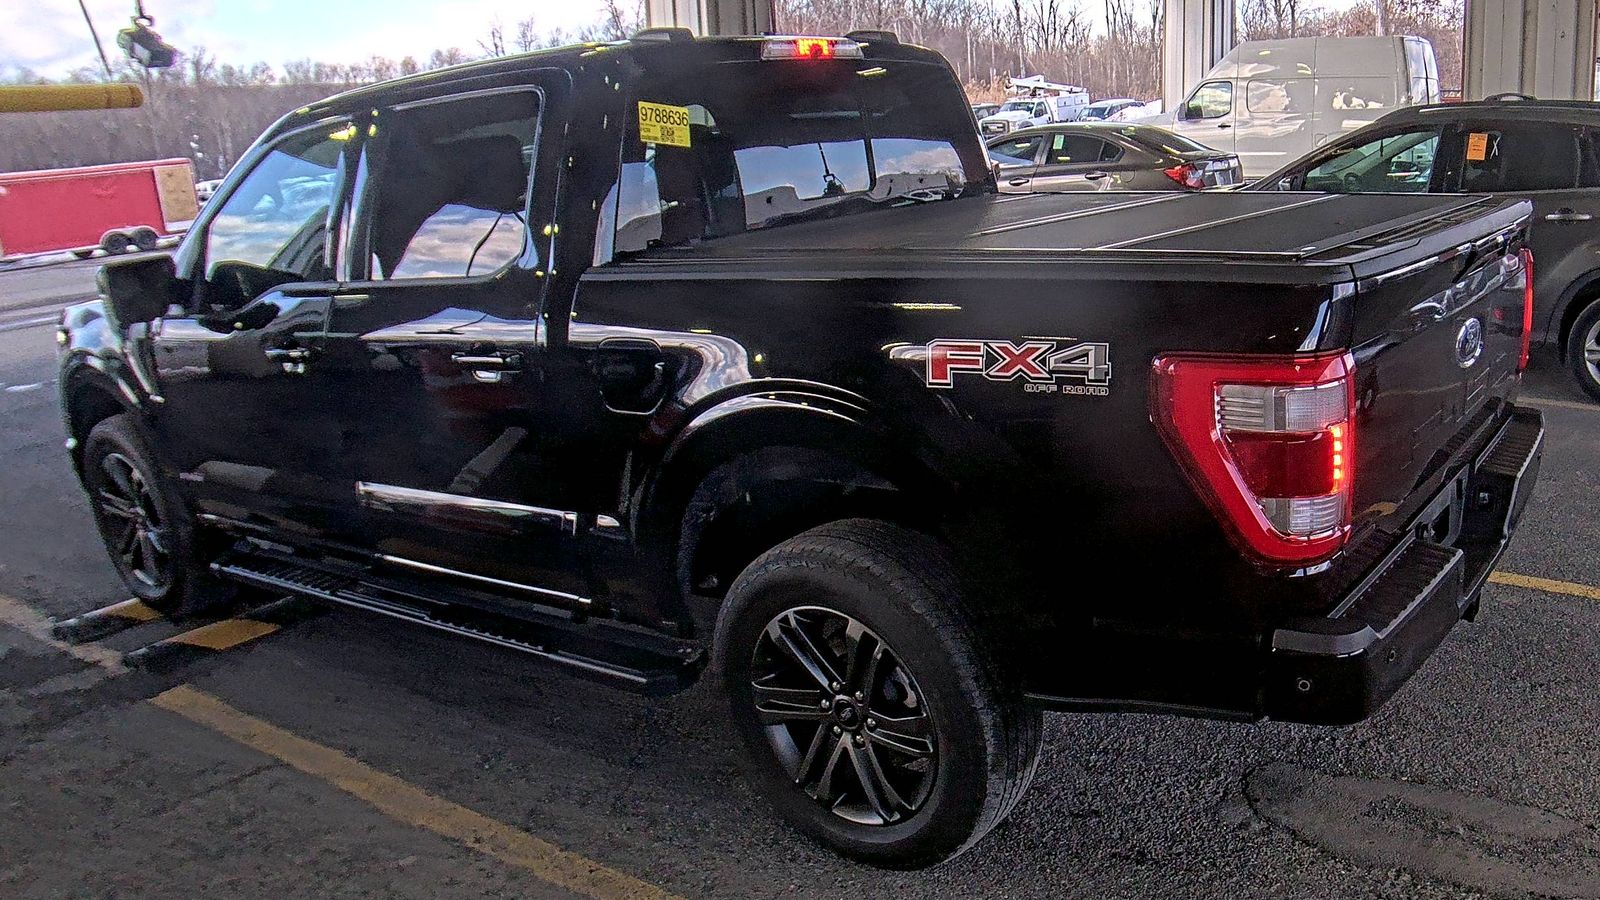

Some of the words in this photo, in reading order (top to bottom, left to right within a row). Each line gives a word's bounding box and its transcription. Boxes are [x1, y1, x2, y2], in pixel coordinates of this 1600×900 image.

[640, 106, 689, 127] 9788636
[926, 338, 1111, 389] FX4
[1024, 383, 1057, 393] OFF
[1062, 384, 1109, 396] ROAD
